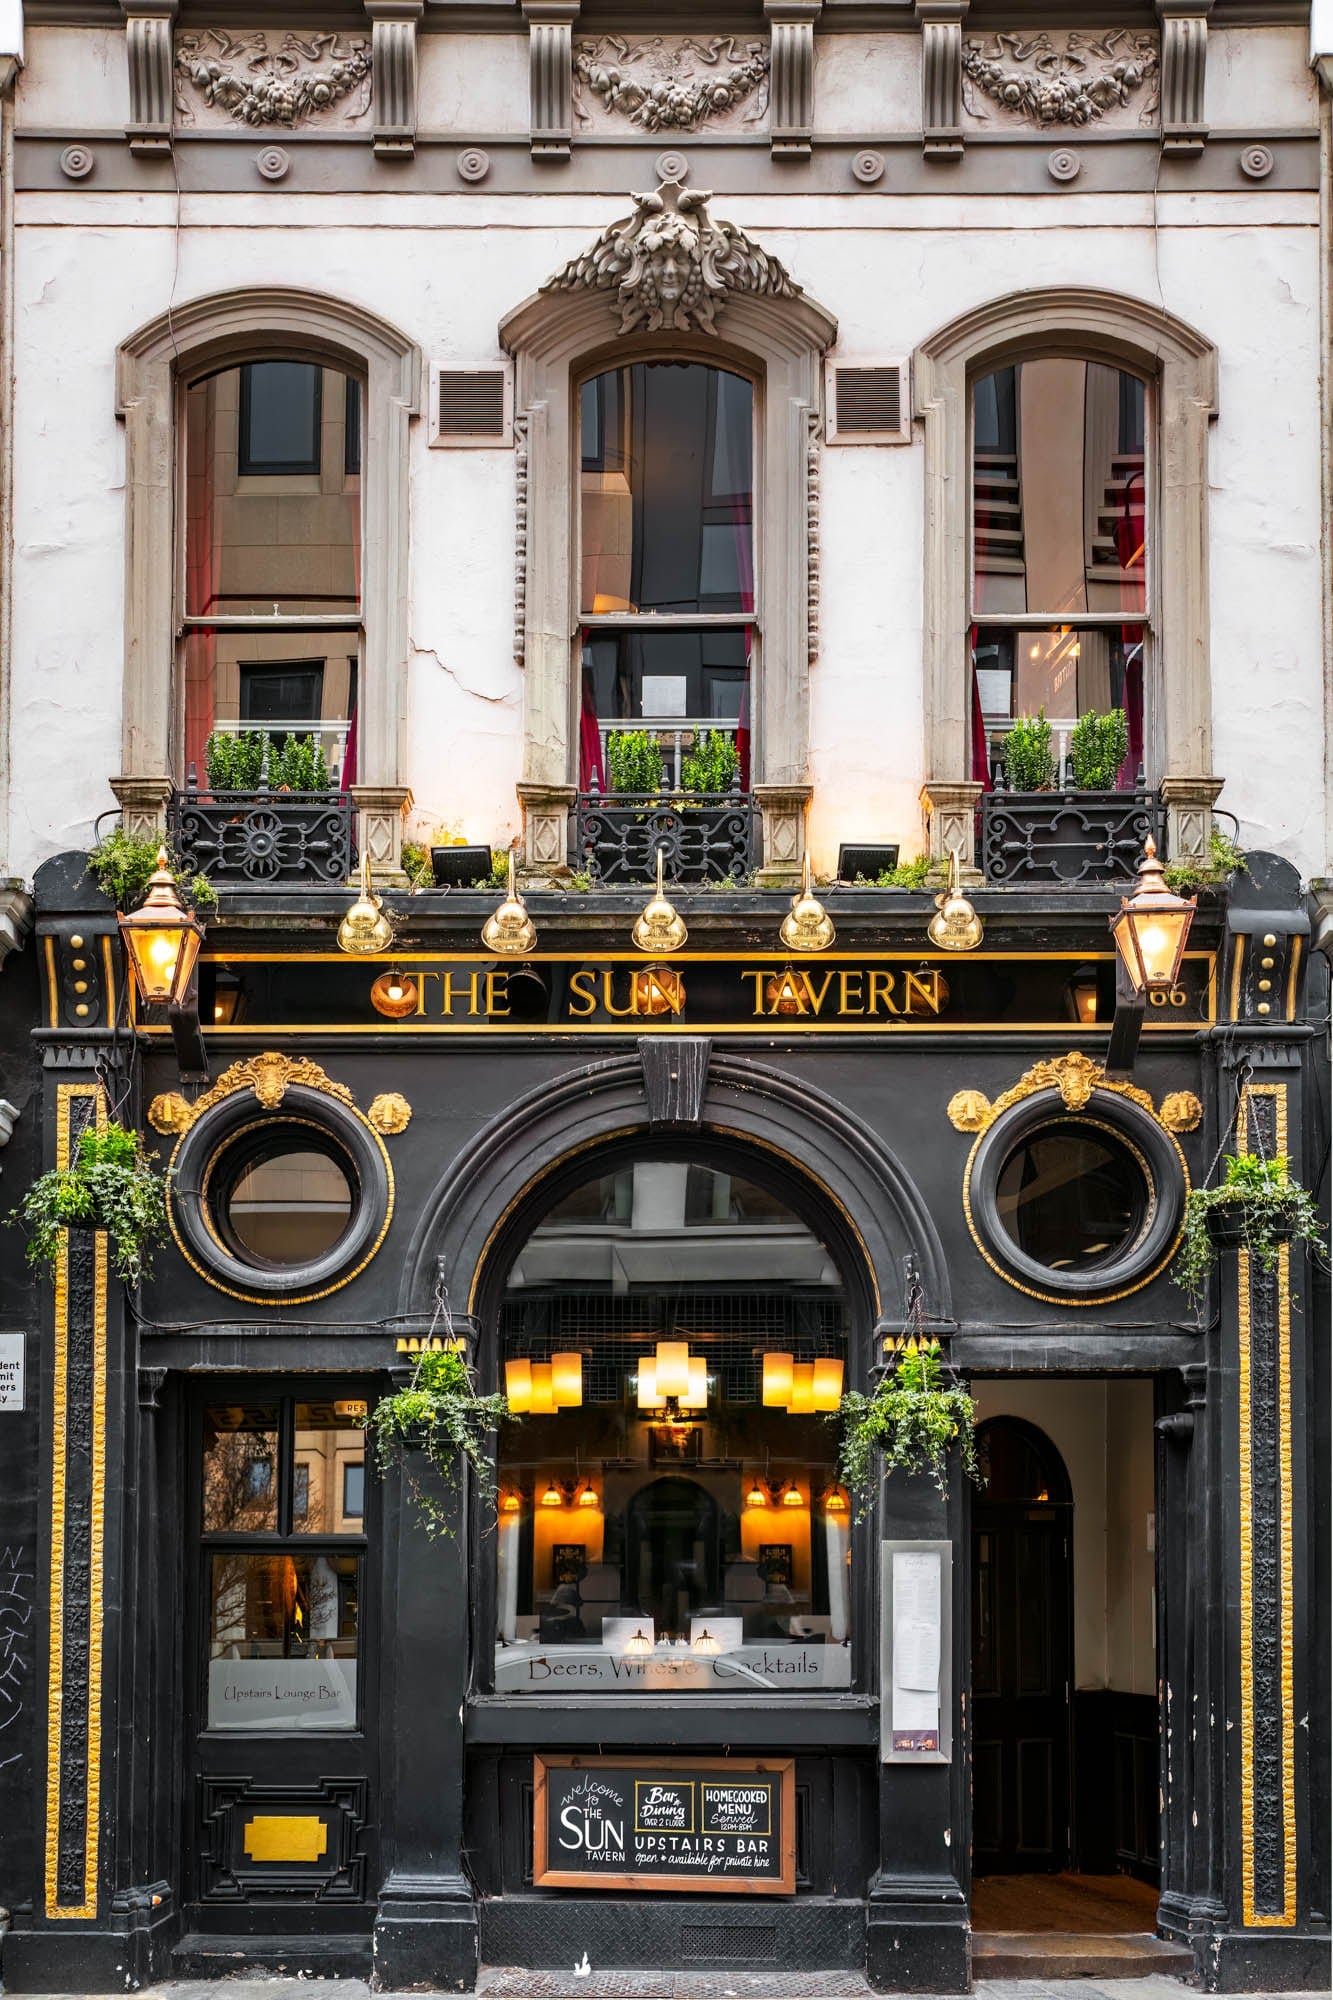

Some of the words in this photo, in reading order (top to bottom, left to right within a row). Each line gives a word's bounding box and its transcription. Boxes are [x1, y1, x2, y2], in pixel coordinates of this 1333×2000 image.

[403, 971, 511, 1016] THE
[569, 970, 684, 1017] SUN
[741, 970, 942, 1016] TAVERN
[347, 1404, 366, 1412] RES
[529, 1655, 603, 1680] Beers,
[713, 1651, 818, 1678] Cocktails
[224, 1685, 272, 1702] Upstairs
[275, 1685, 316, 1702] Lounge
[319, 1685, 341, 1700] Bar
[560, 1774, 624, 1807] welcome
[645, 1786, 679, 1804] Bar
[705, 1789, 768, 1804] HOMECOOKED
[585, 1792, 599, 1807] to
[583, 1807, 602, 1819] THE
[640, 1804, 685, 1820] Dining
[718, 1803, 752, 1815] MENU
[644, 1817, 658, 1827] OVER
[658, 1818, 664, 1827] 2
[665, 1819, 686, 1828] FLOORS
[710, 1811, 758, 1824] Served
[559, 1806, 624, 1850] SUN
[634, 1836, 725, 1852] UPSTAIRS
[737, 1839, 768, 1853] BAR
[585, 1850, 626, 1862] TAVERN
[635, 1853, 658, 1866] open
[668, 1852, 708, 1866] available
[708, 1855, 725, 1872] for
[724, 1854, 752, 1871] private
[754, 1855, 770, 1867] hire
